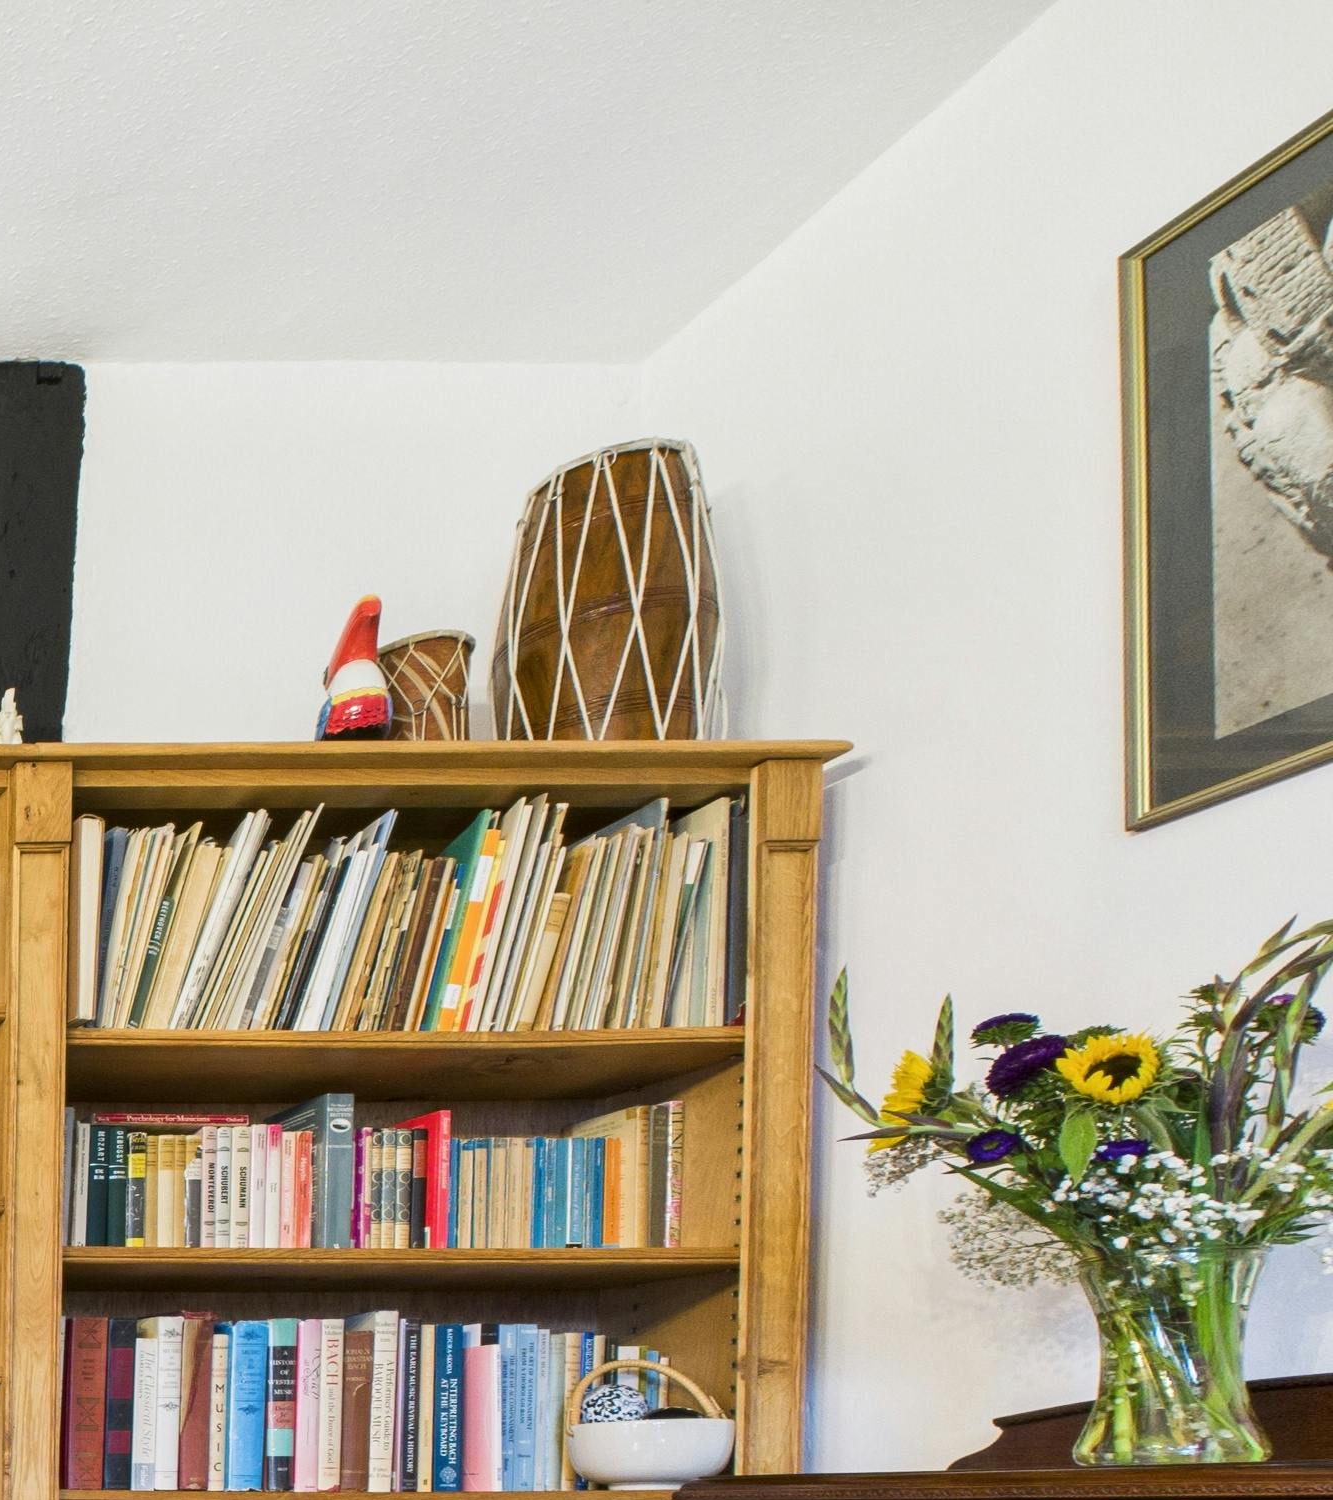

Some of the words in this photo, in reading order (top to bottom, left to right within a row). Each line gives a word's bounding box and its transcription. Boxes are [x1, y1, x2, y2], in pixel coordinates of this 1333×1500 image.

[151, 900, 171, 940] BEETHOVEN
[96, 1131, 105, 1161] MOZART
[115, 1130, 124, 1163] DEBUSSY
[206, 1162, 215, 1213] MONTEVERDI
[219, 1165, 229, 1205] SCHUBERT
[238, 1166, 248, 1208] SCHUMANN
[325, 1338, 339, 1386] BACH
[440, 1378, 449, 1388] AT
[440, 1391, 449, 1409] THE
[449, 1378, 459, 1441] INTERPRETING
[439, 1411, 450, 1456] KEYBOARD
[447, 1442, 457, 1464] BACH
